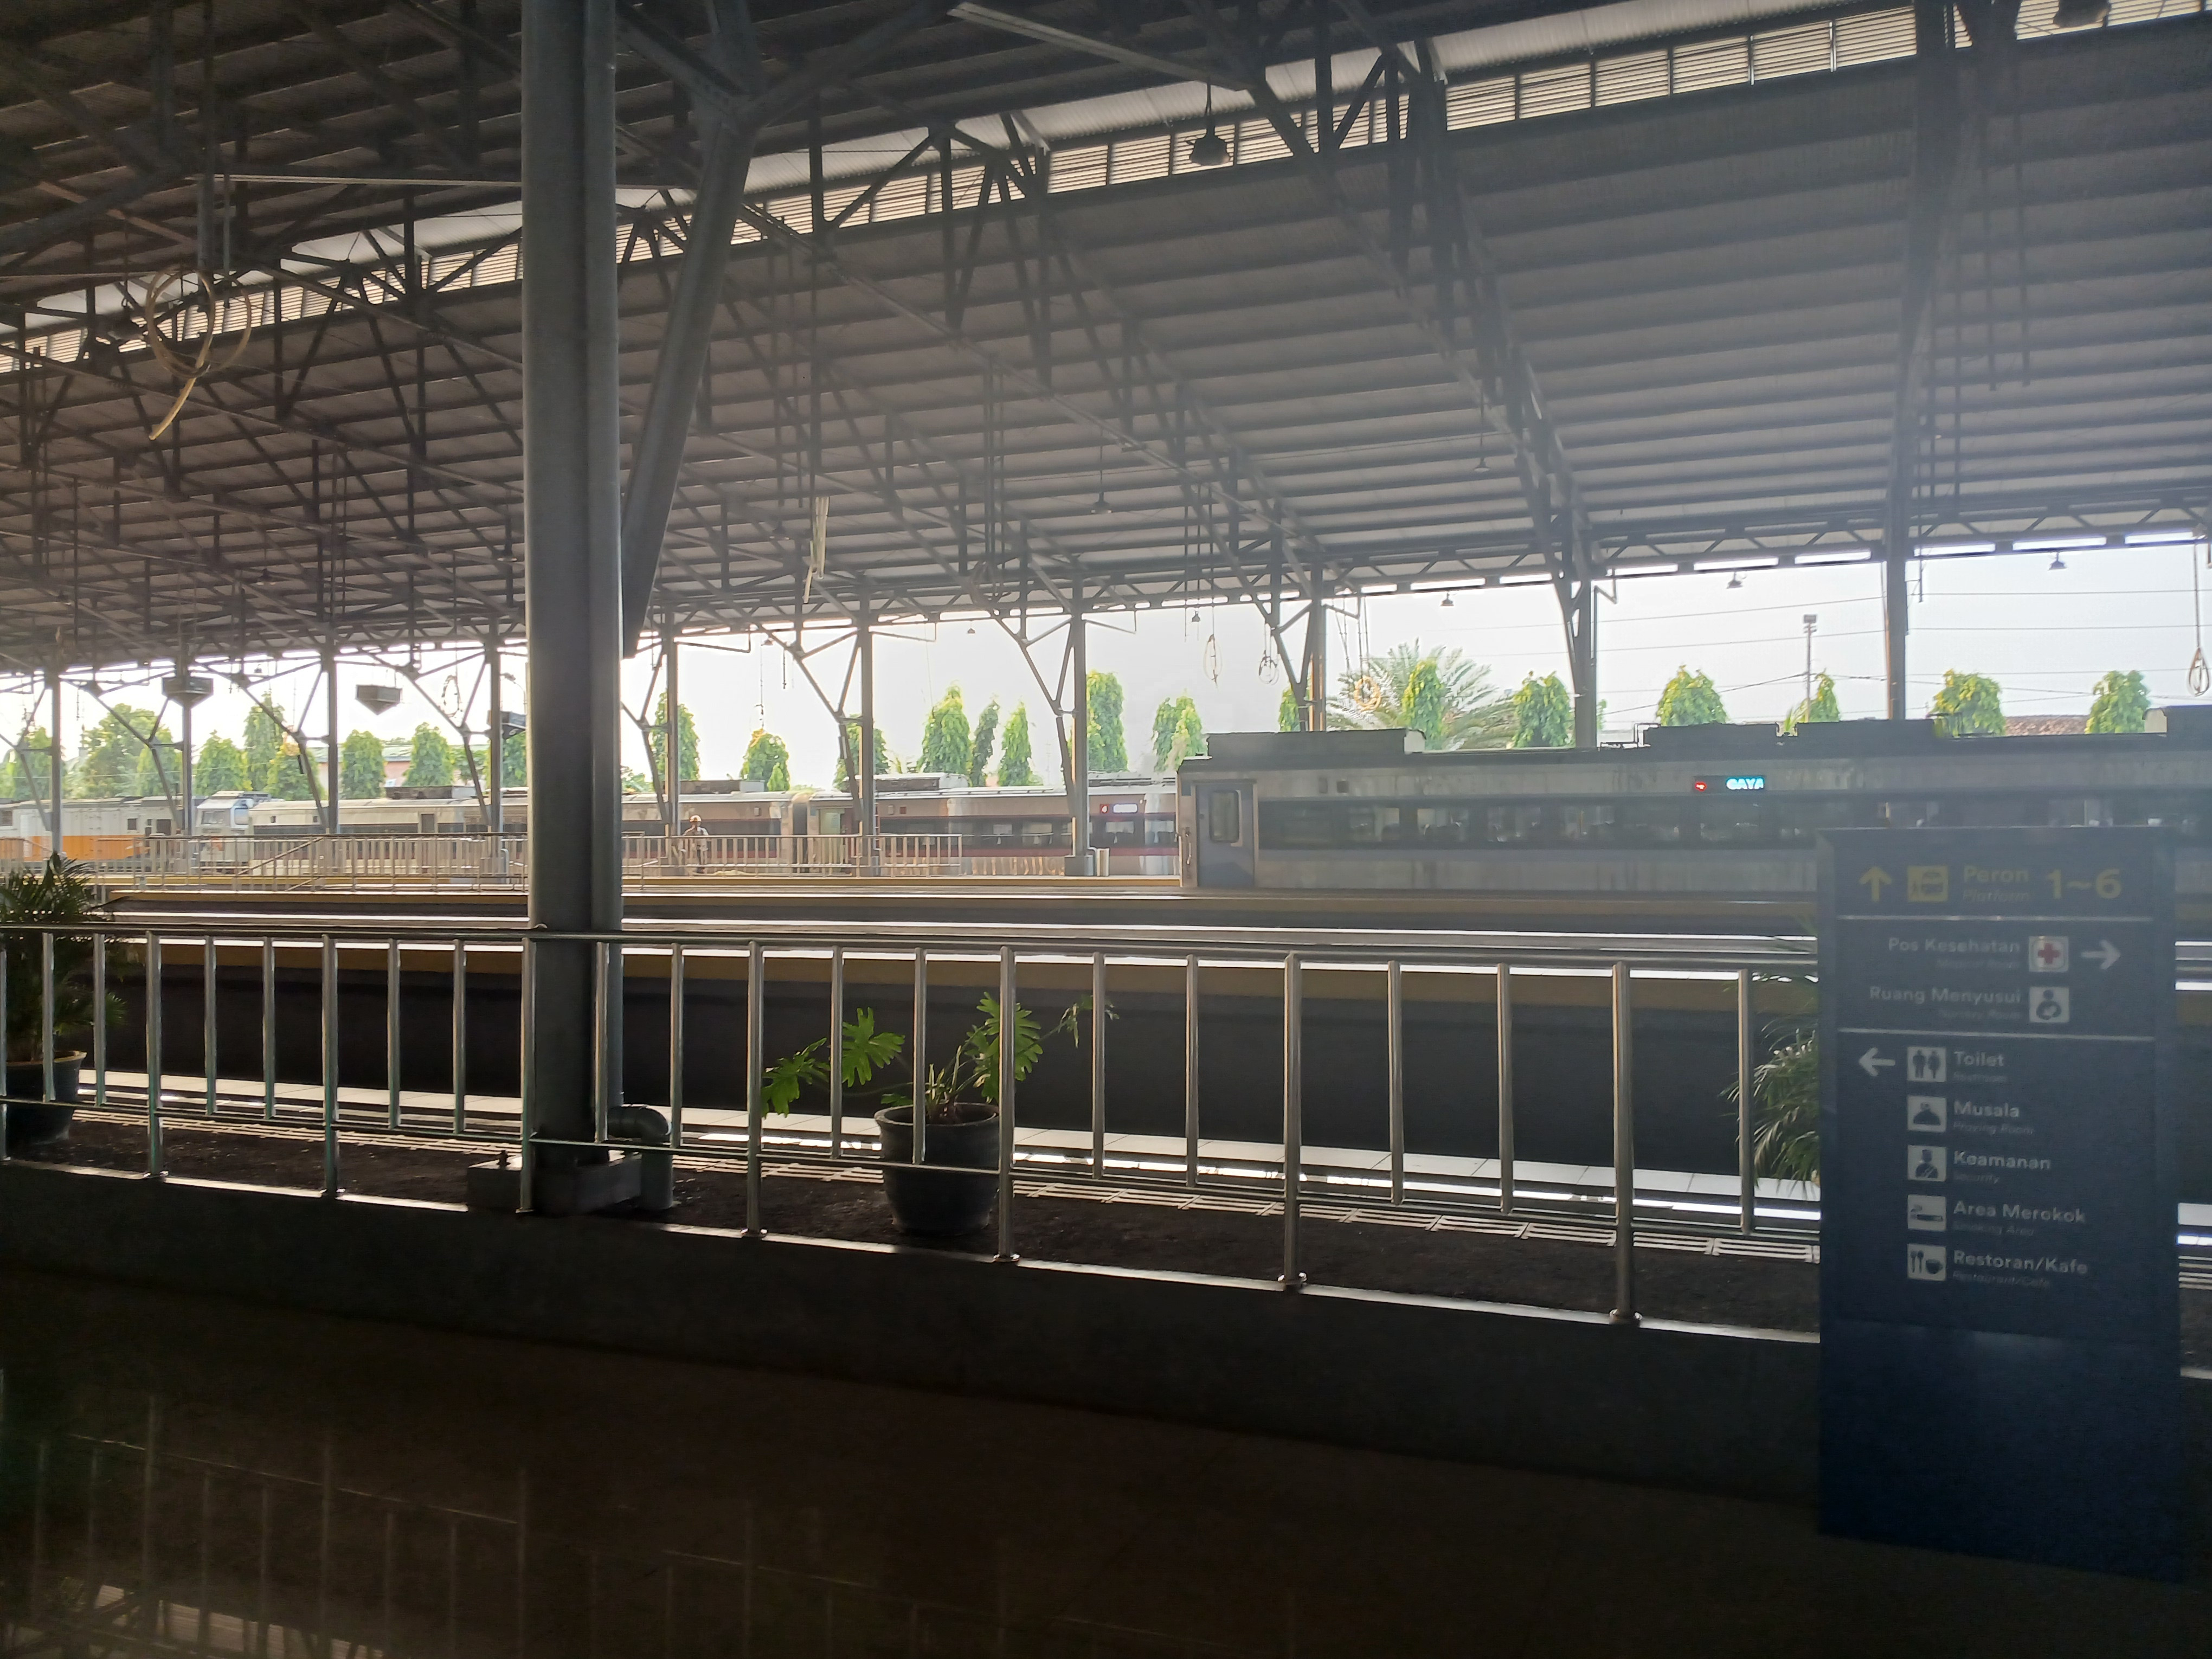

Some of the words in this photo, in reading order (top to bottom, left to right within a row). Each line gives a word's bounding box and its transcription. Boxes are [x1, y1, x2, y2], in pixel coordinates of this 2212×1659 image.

[1963, 865, 2029, 883] Peron
[1963, 889, 2030, 902] Platform
[1888, 937, 1918, 951] Pos
[1925, 938, 2020, 953] Kesehatan
[1869, 986, 1925, 1005] Ruang
[1931, 987, 2021, 1006] Menyusui
[1953, 1051, 2004, 1067] Toilet
[1953, 1100, 2020, 1118] Musala
[1953, 1150, 2051, 1170] Keamanan
[1953, 1200, 1996, 1217] Area
[2003, 1203, 2086, 1223] Merokok
[1953, 1250, 2088, 1275] Restoran/Kafe
